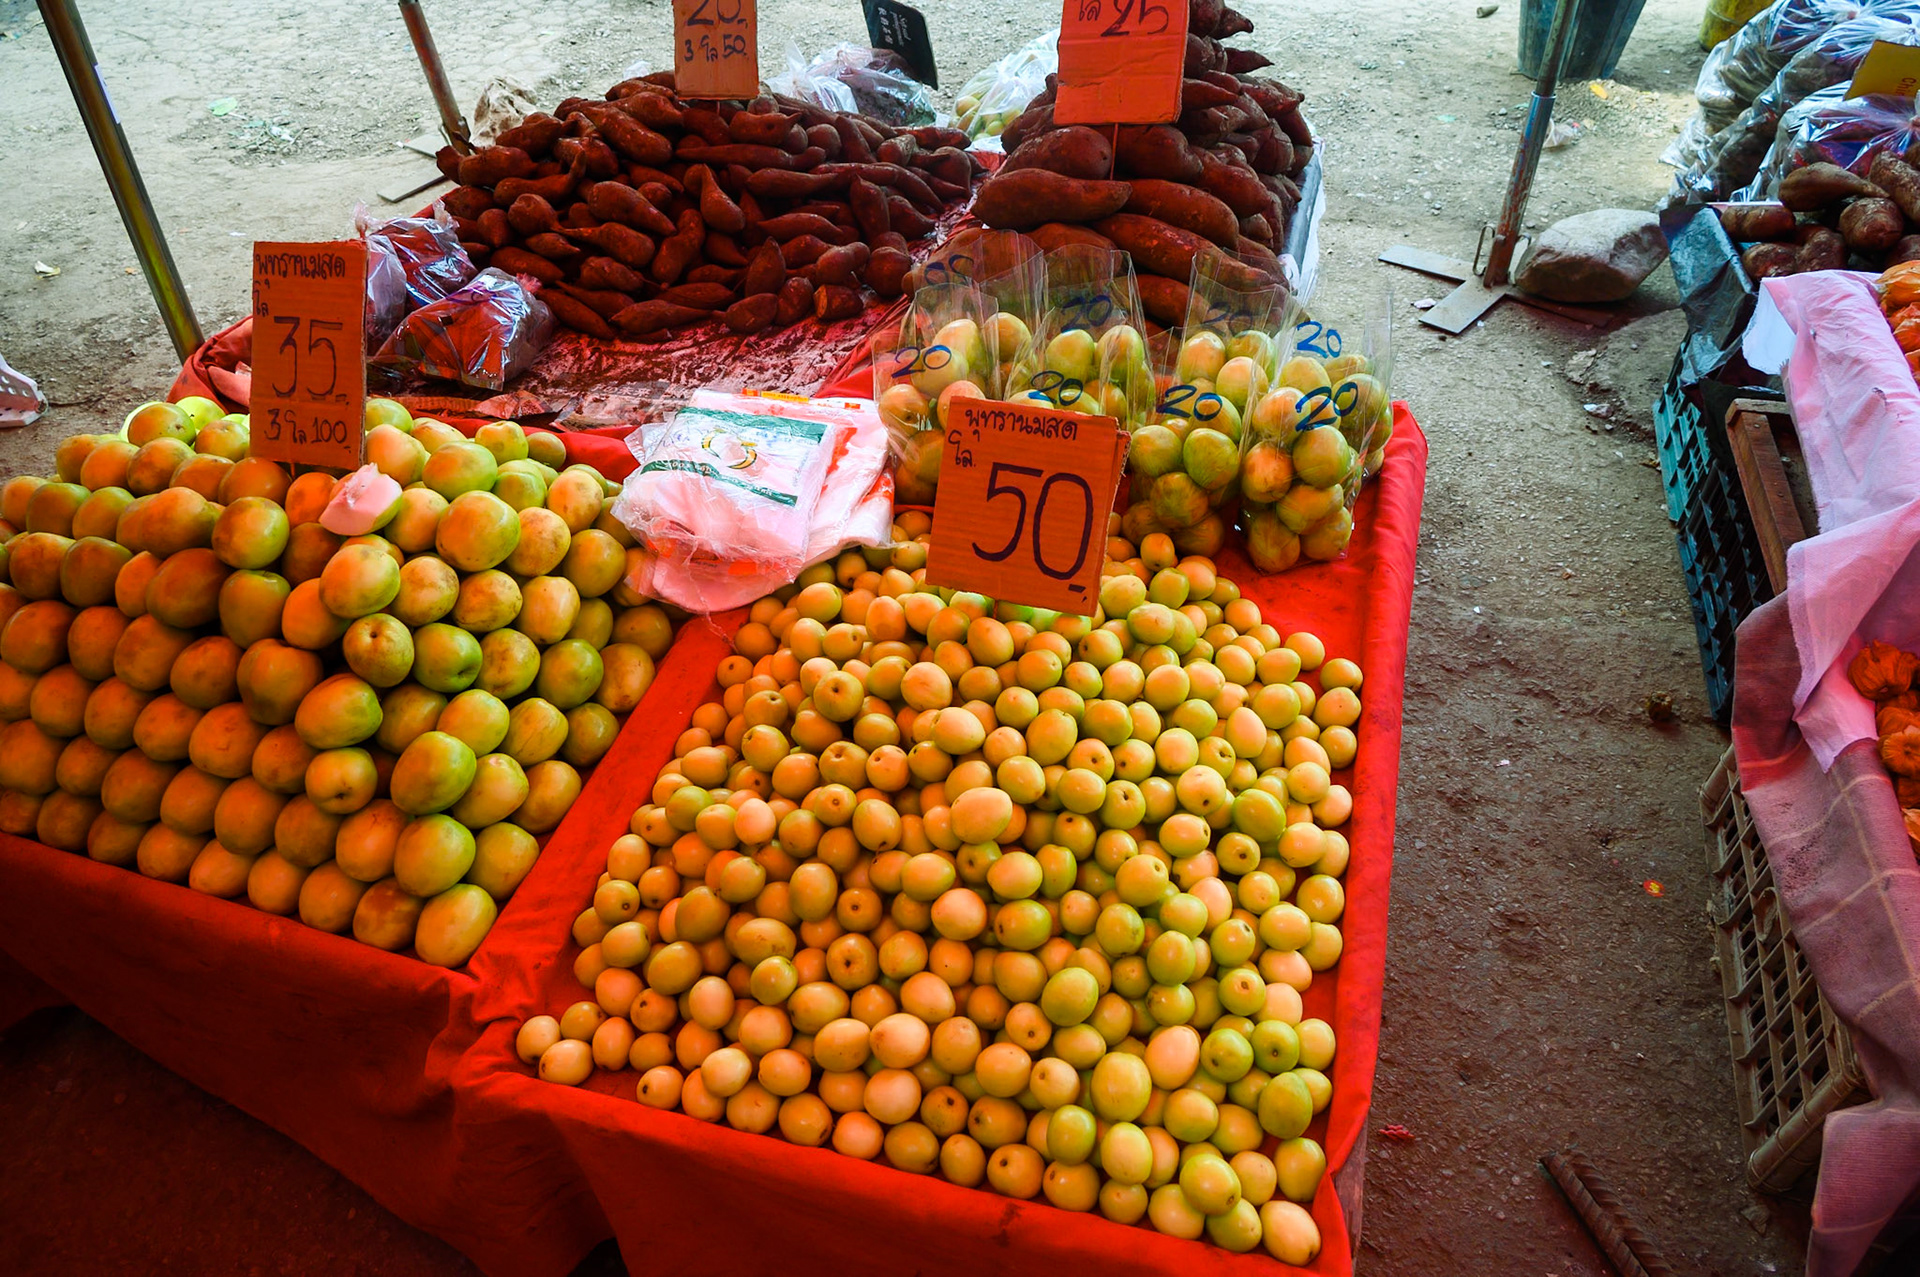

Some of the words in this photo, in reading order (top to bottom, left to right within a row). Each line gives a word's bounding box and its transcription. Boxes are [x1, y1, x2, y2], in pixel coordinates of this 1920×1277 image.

[1060, 294, 1113, 334] 20
[1296, 320, 1342, 359] 20
[891, 344, 952, 378] 20
[1031, 370, 1084, 406] 20
[1156, 384, 1223, 422] 20
[1295, 381, 1359, 432] 20
[264, 408, 281, 440] 3
